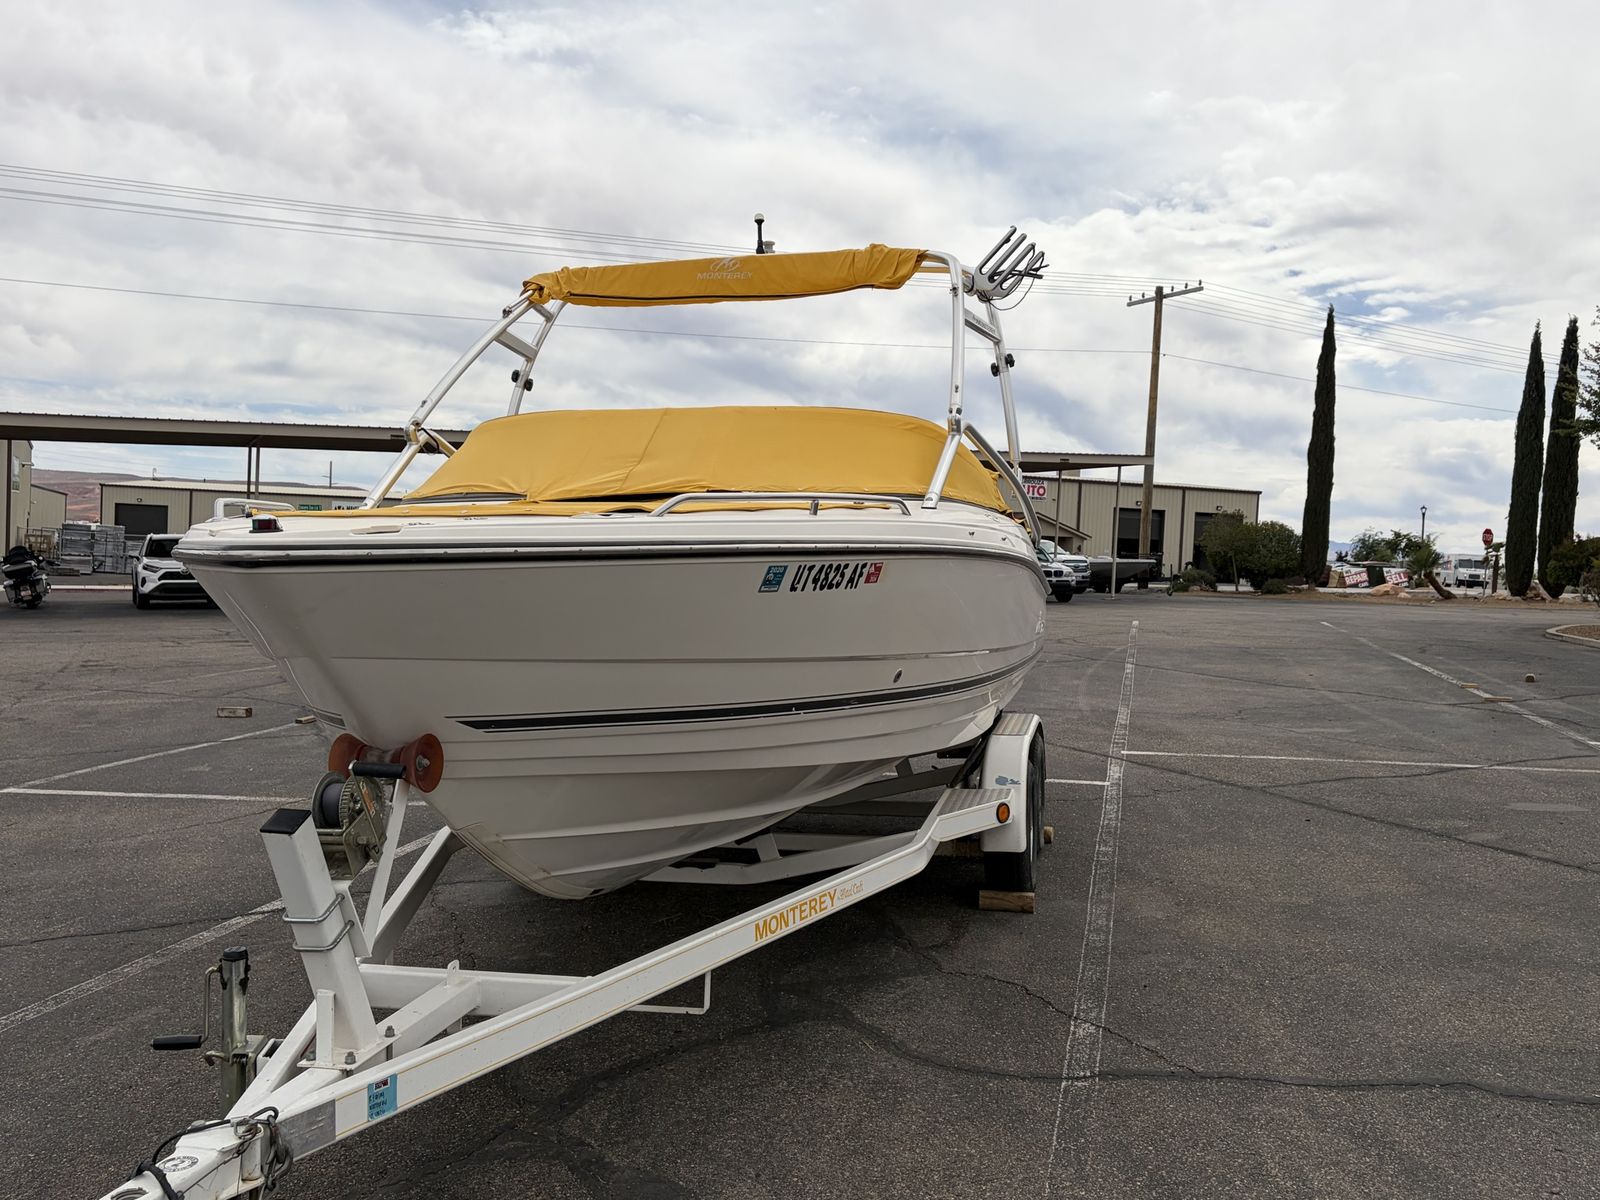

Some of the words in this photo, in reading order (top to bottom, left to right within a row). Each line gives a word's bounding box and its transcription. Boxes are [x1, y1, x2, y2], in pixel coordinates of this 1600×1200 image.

[697, 271, 753, 280] MONTEREY
[1022, 484, 1046, 496] UTO
[844, 562, 868, 589] AF
[1345, 571, 1369, 585] REPAIR
[1387, 572, 1408, 585] SELL
[754, 888, 837, 942] MONTEREY
